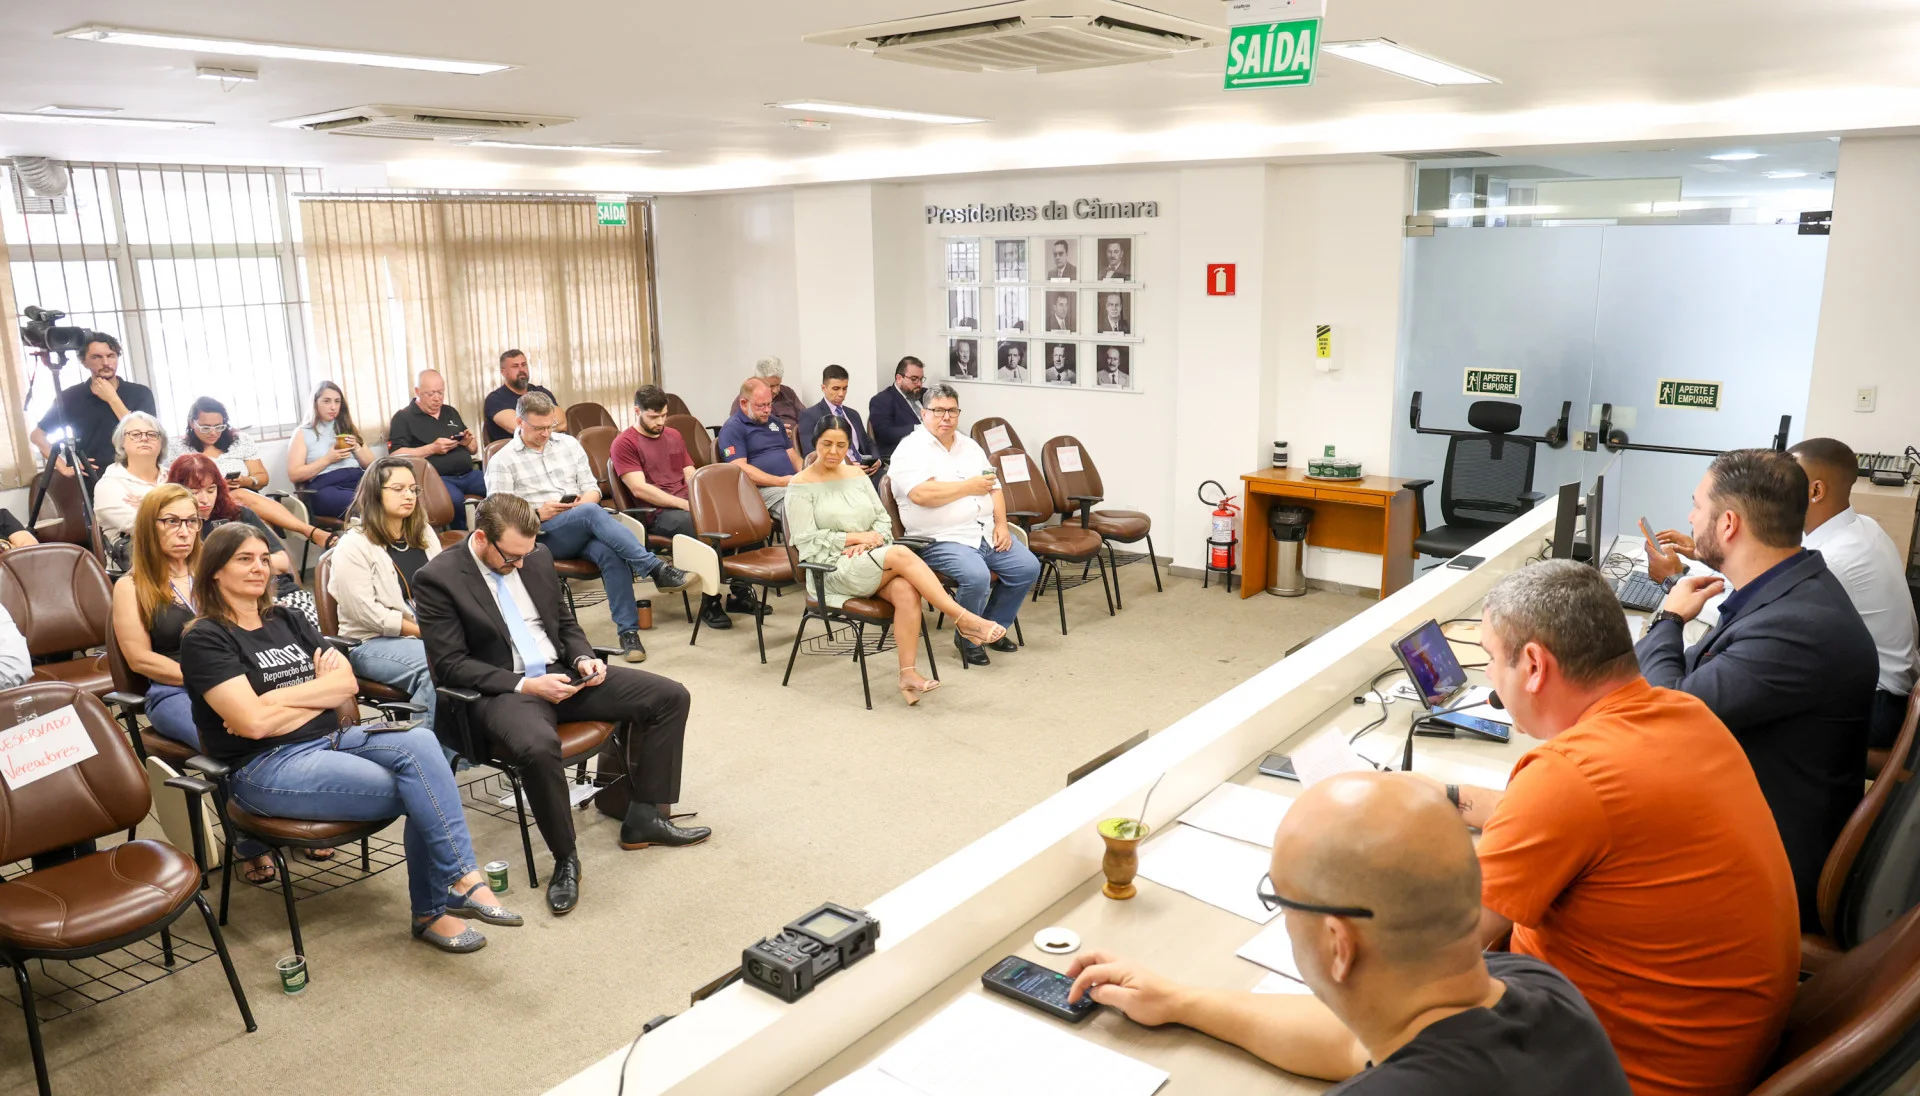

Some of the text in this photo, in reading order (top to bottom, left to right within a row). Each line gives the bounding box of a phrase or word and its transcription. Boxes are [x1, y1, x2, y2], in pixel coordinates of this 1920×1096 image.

[1227, 23, 1311, 75] SAÍDA
[598, 202, 626, 221] SAÍDA
[925, 198, 1159, 224] Presidentes da Câmara
[1482, 382, 1514, 392] EMPURRE
[1483, 373, 1515, 383] APERTE E
[1677, 394, 1714, 405] EMPURRE
[1678, 385, 1716, 396] APERTE E
[255, 643, 310, 669] JUSTIÇA
[263, 667, 300, 683] Reparação
[300, 663, 308, 672] da
[4, 746, 80, 780] Vereadores
